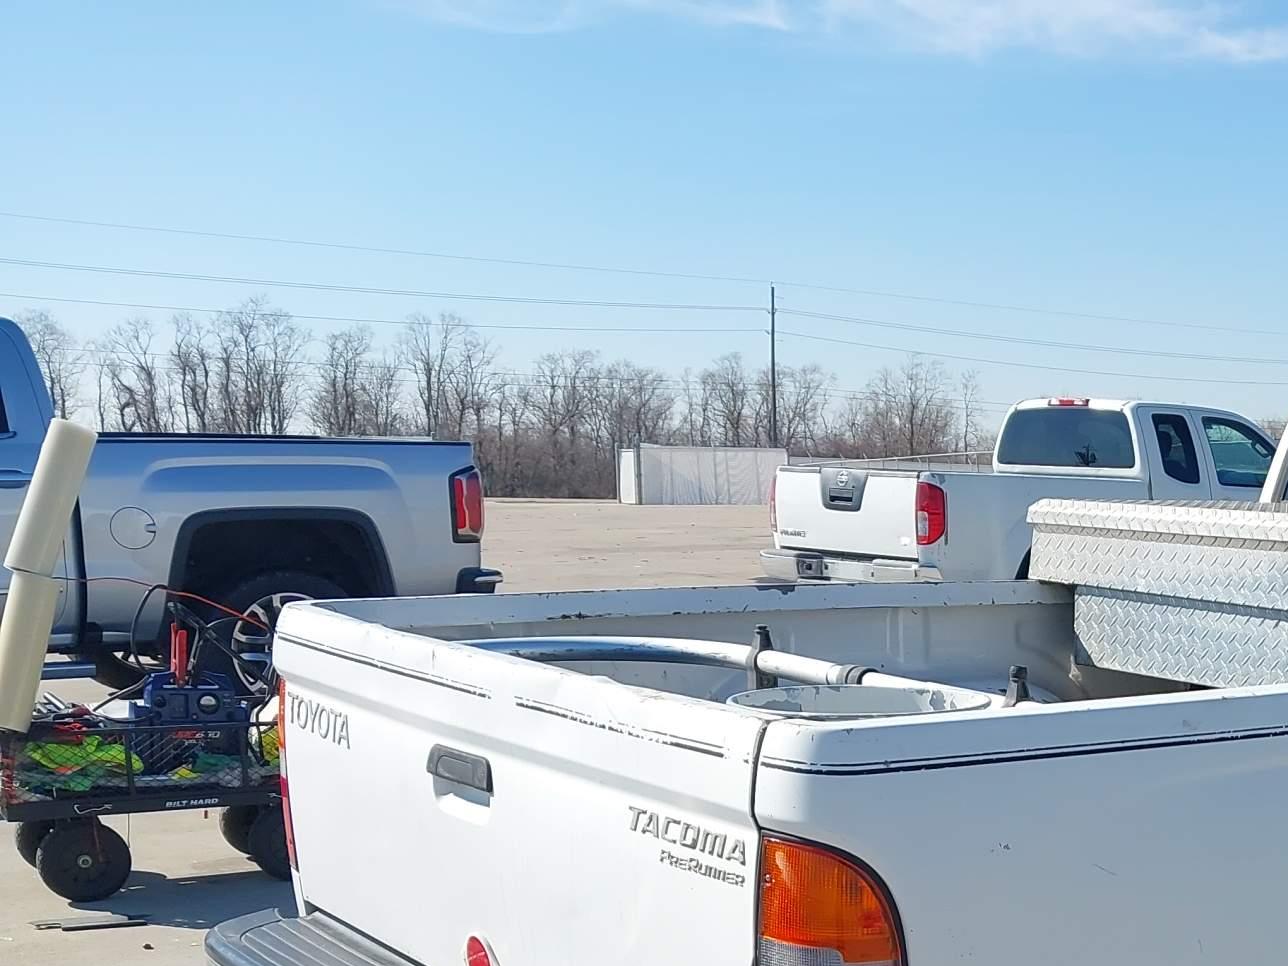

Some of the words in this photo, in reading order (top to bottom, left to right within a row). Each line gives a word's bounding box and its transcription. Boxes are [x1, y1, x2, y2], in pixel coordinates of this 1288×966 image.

[287, 691, 351, 750] TOYOTA
[165, 800, 188, 808] BILT
[190, 798, 219, 806] HARD
[628, 806, 746, 867] TACOMA
